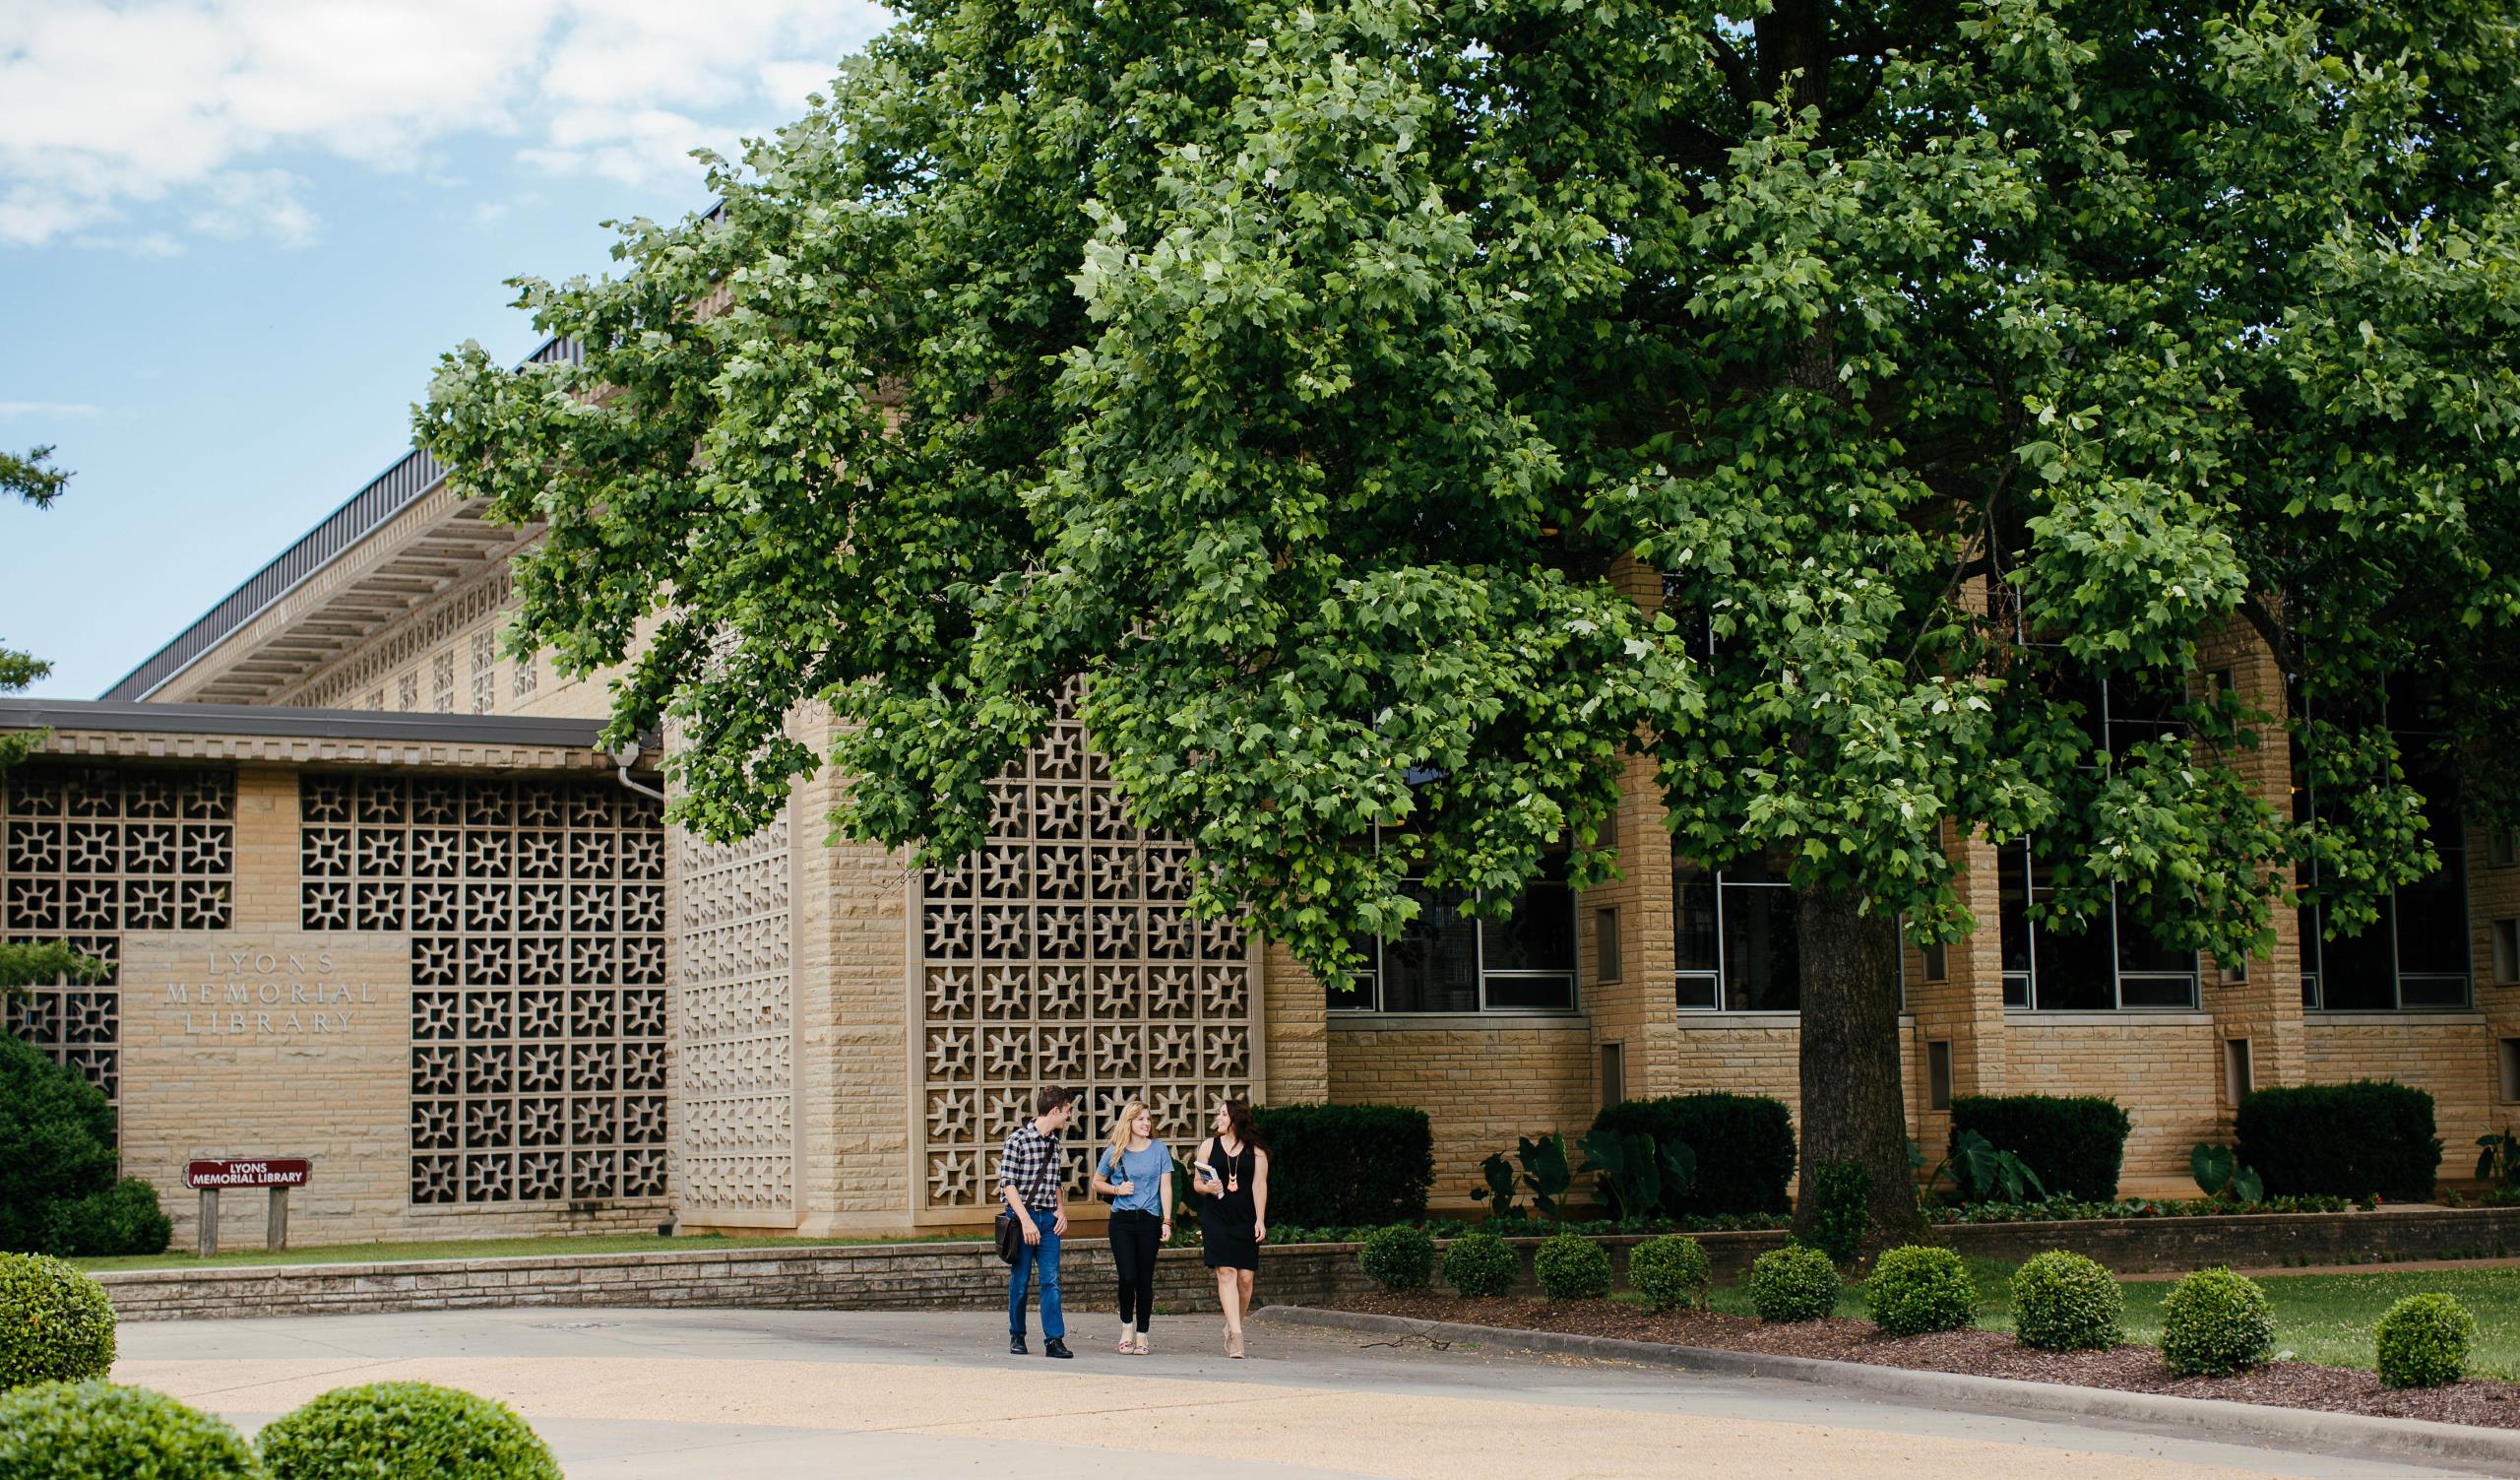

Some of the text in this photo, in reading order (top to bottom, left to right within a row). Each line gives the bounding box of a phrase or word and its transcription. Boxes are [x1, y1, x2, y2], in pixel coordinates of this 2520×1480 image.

[209, 953, 333, 975] LYONS
[164, 983, 378, 1004] MEMORIAL
[185, 1010, 354, 1034] LIBRARY
[193, 1172, 302, 1185] MEMORIAL LIBRARY
[229, 1163, 267, 1174] LYONS
